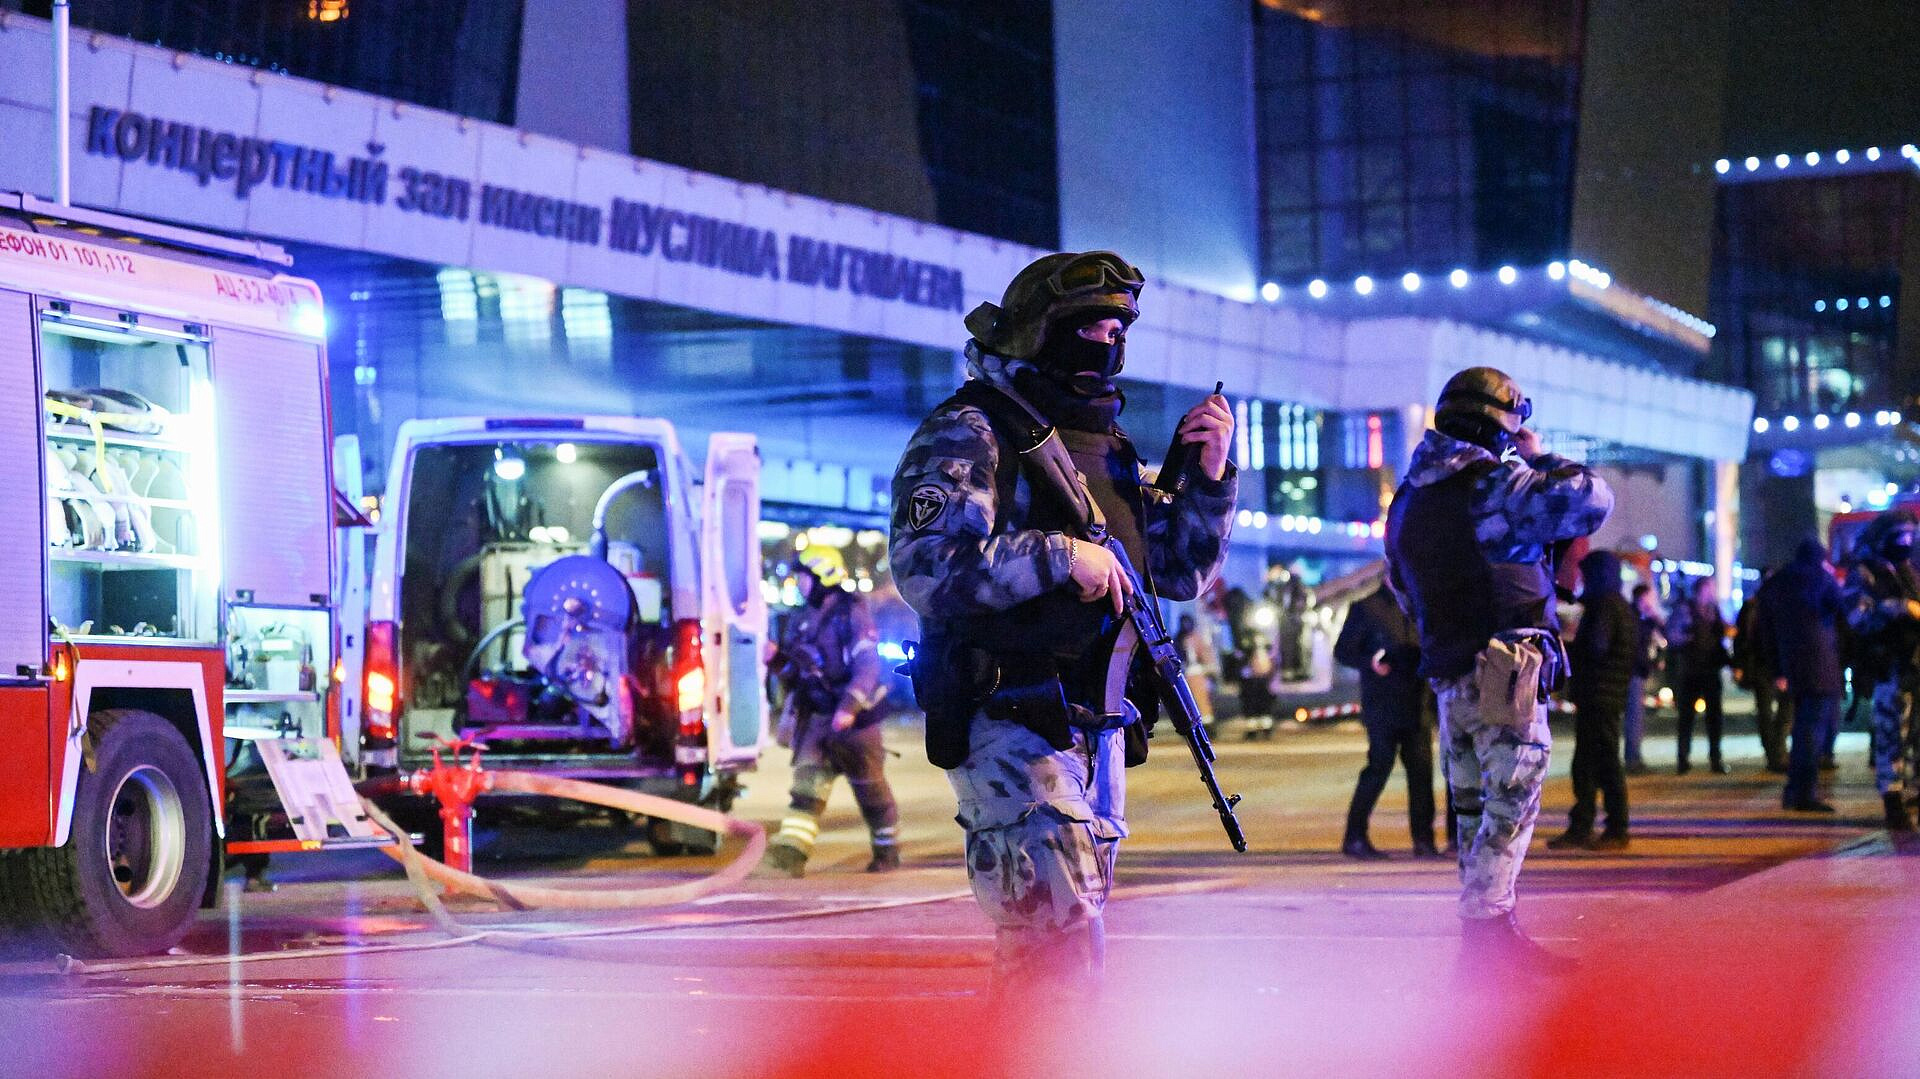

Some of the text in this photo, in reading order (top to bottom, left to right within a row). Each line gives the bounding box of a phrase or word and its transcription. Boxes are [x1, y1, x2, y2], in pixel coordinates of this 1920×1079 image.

[48, 240, 68, 262] 01
[397, 165, 470, 222] зал
[609, 197, 779, 281] МУСЛИМА
[787, 234, 965, 313] МАГОМАЕВА
